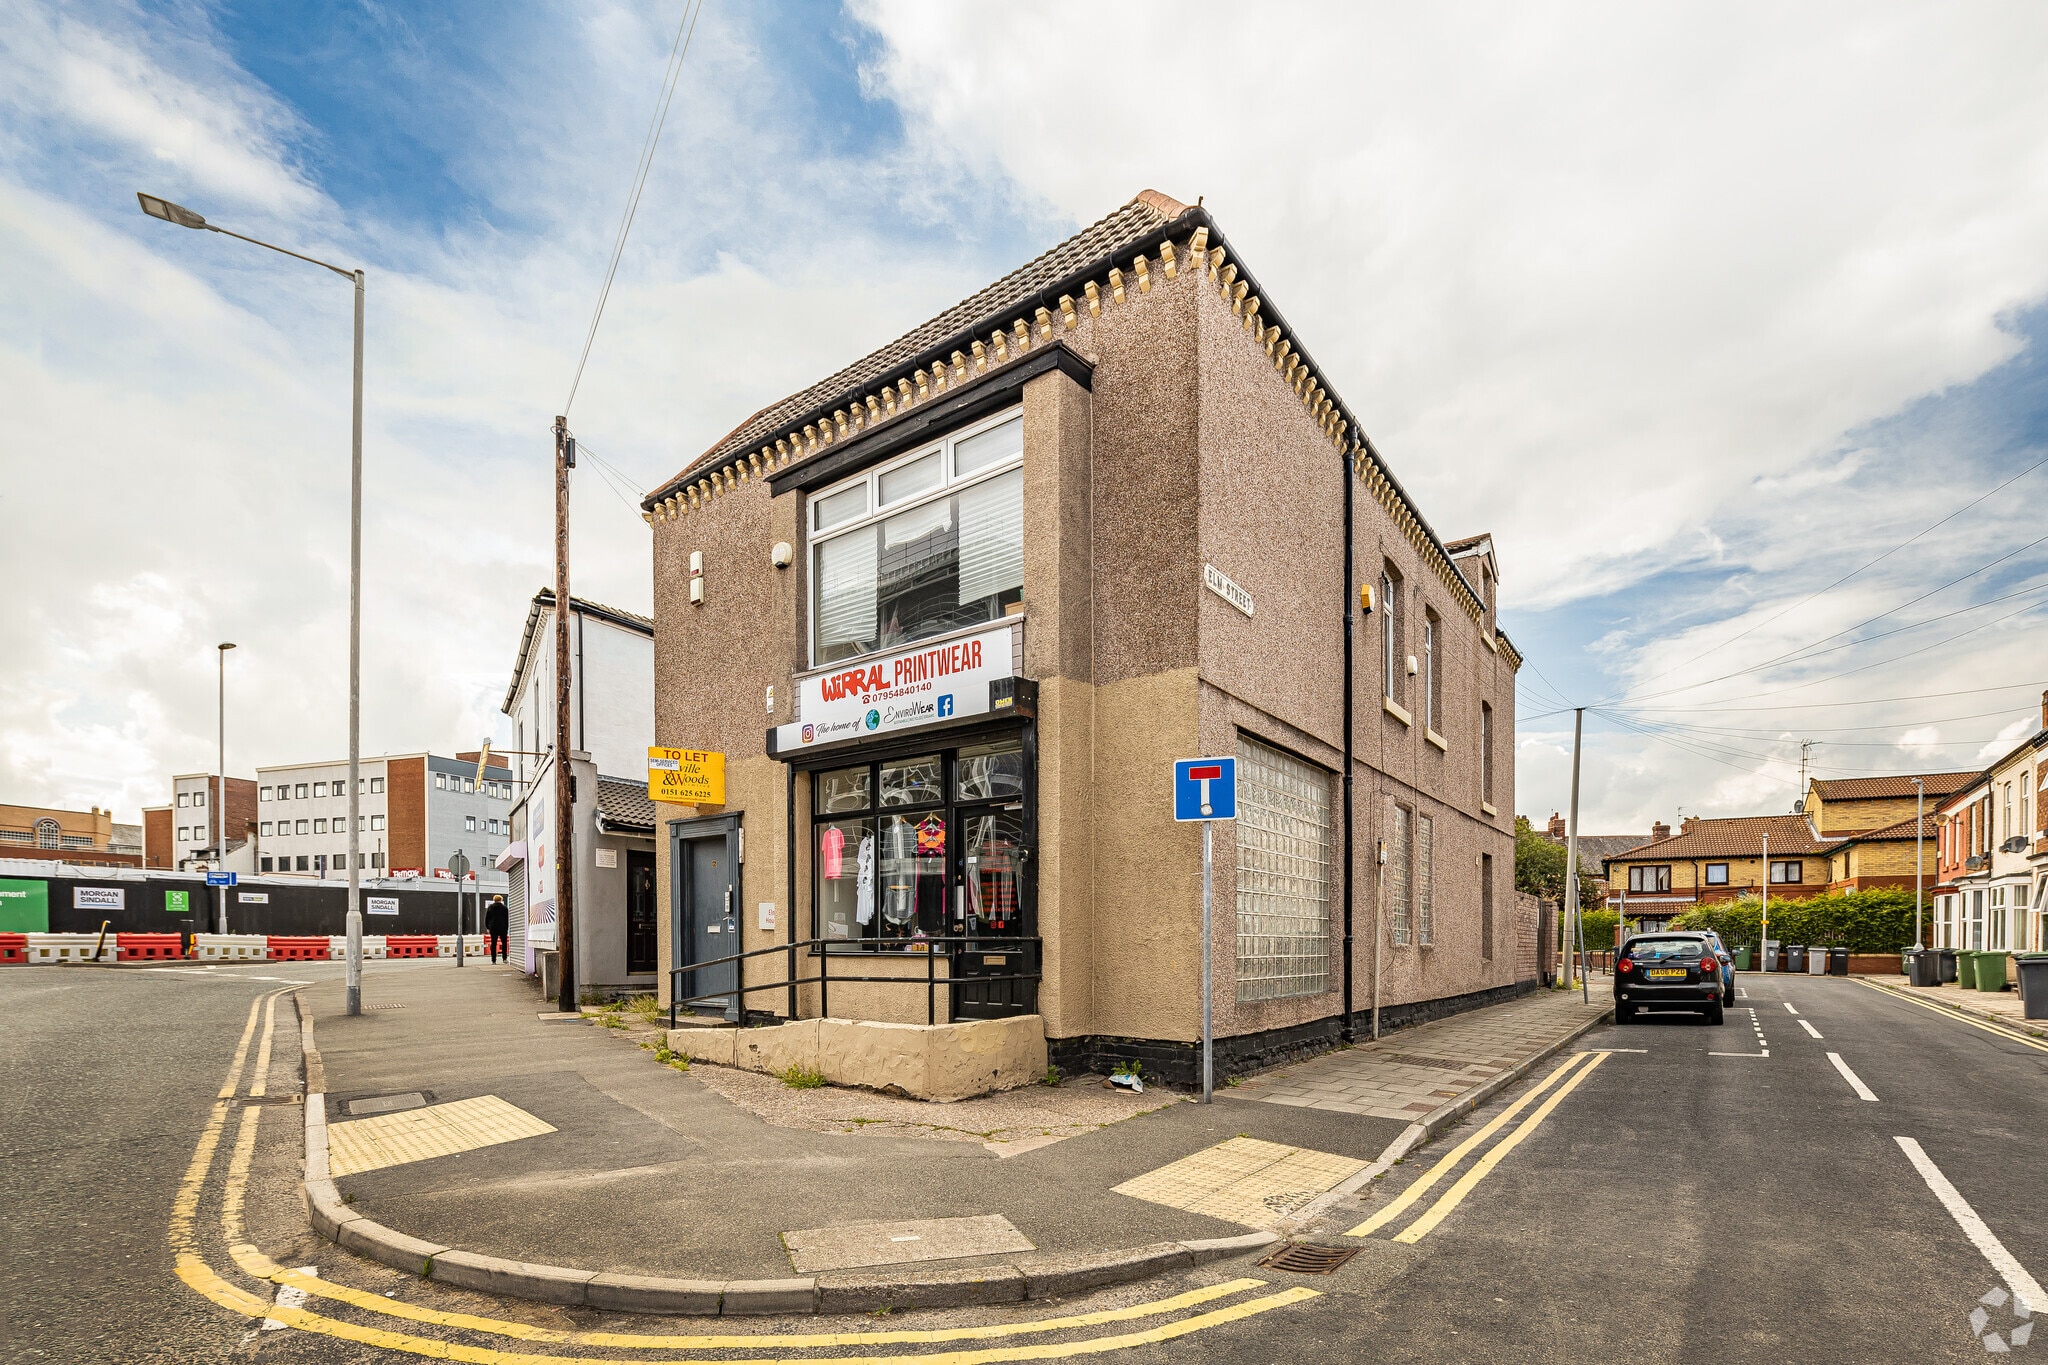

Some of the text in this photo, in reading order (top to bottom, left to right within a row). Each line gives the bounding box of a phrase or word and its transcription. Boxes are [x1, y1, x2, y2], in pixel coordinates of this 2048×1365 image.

[1226, 583, 1251, 611] STREET
[894, 640, 982, 687] PRINTWEAR
[872, 681, 932, 702] 07954840140
[815, 723, 829, 737] The
[830, 721, 851, 732] home
[852, 717, 862, 731] of
[663, 750, 708, 762] TO LET
